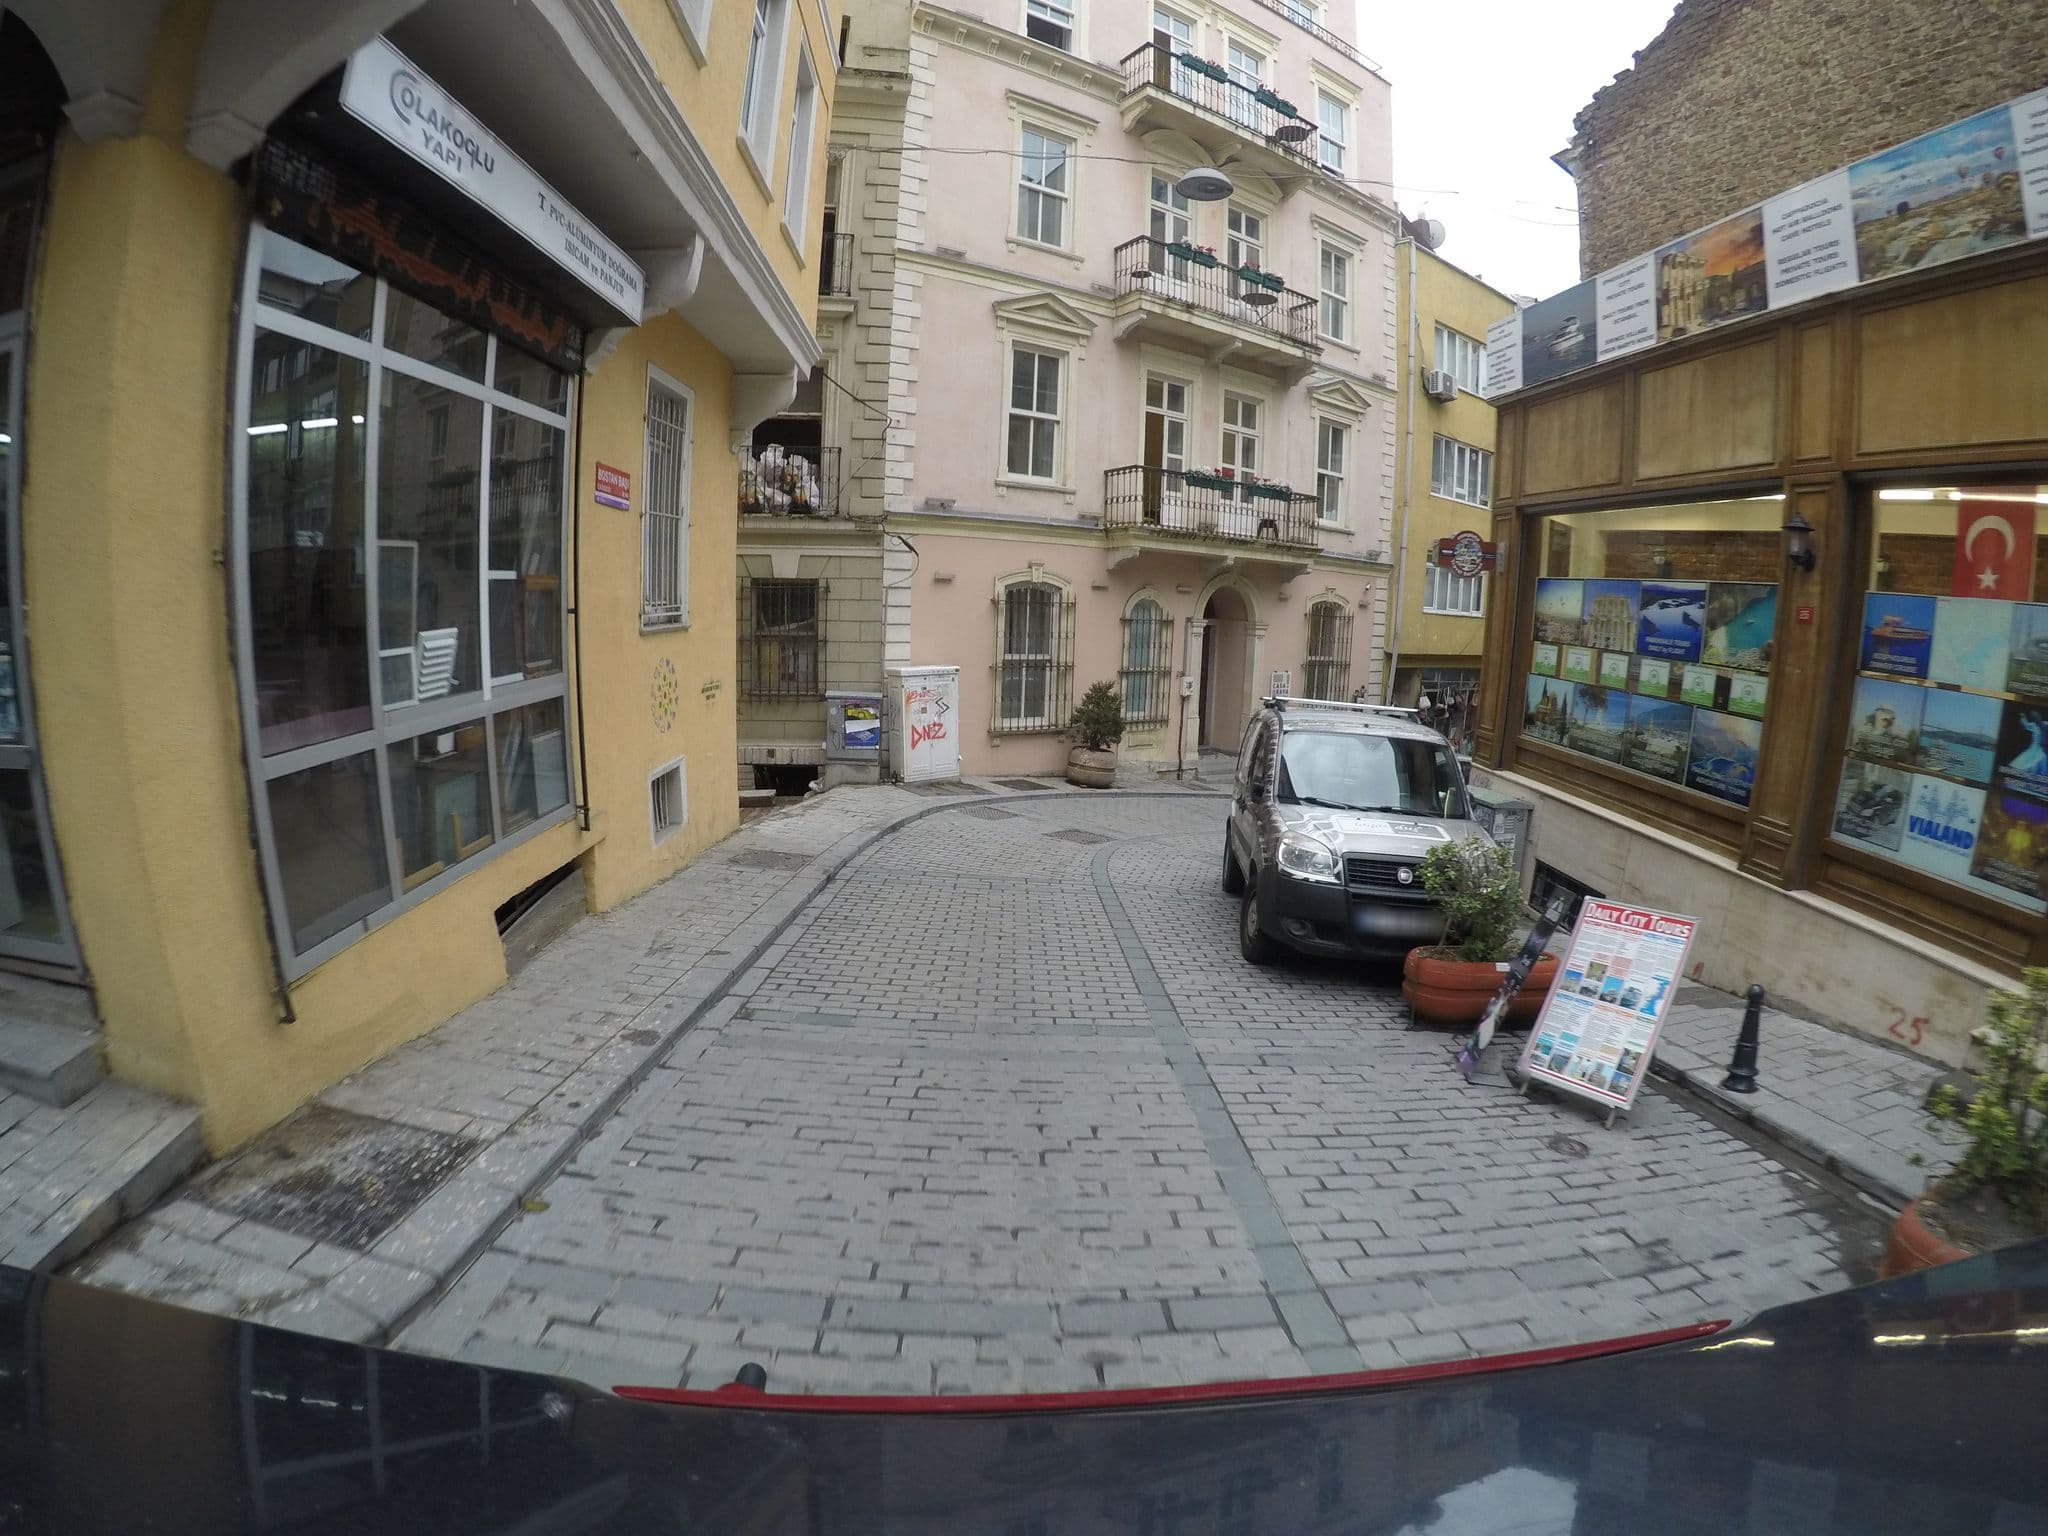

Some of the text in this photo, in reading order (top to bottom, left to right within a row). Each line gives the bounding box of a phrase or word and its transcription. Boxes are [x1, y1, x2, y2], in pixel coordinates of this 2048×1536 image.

[422, 128, 462, 172] YAPI
[1909, 815, 1974, 850] VIALAND
[1584, 903, 1622, 922] DAILY
[1620, 910, 1649, 929] CITY
[1649, 915, 1693, 938] TOURS
